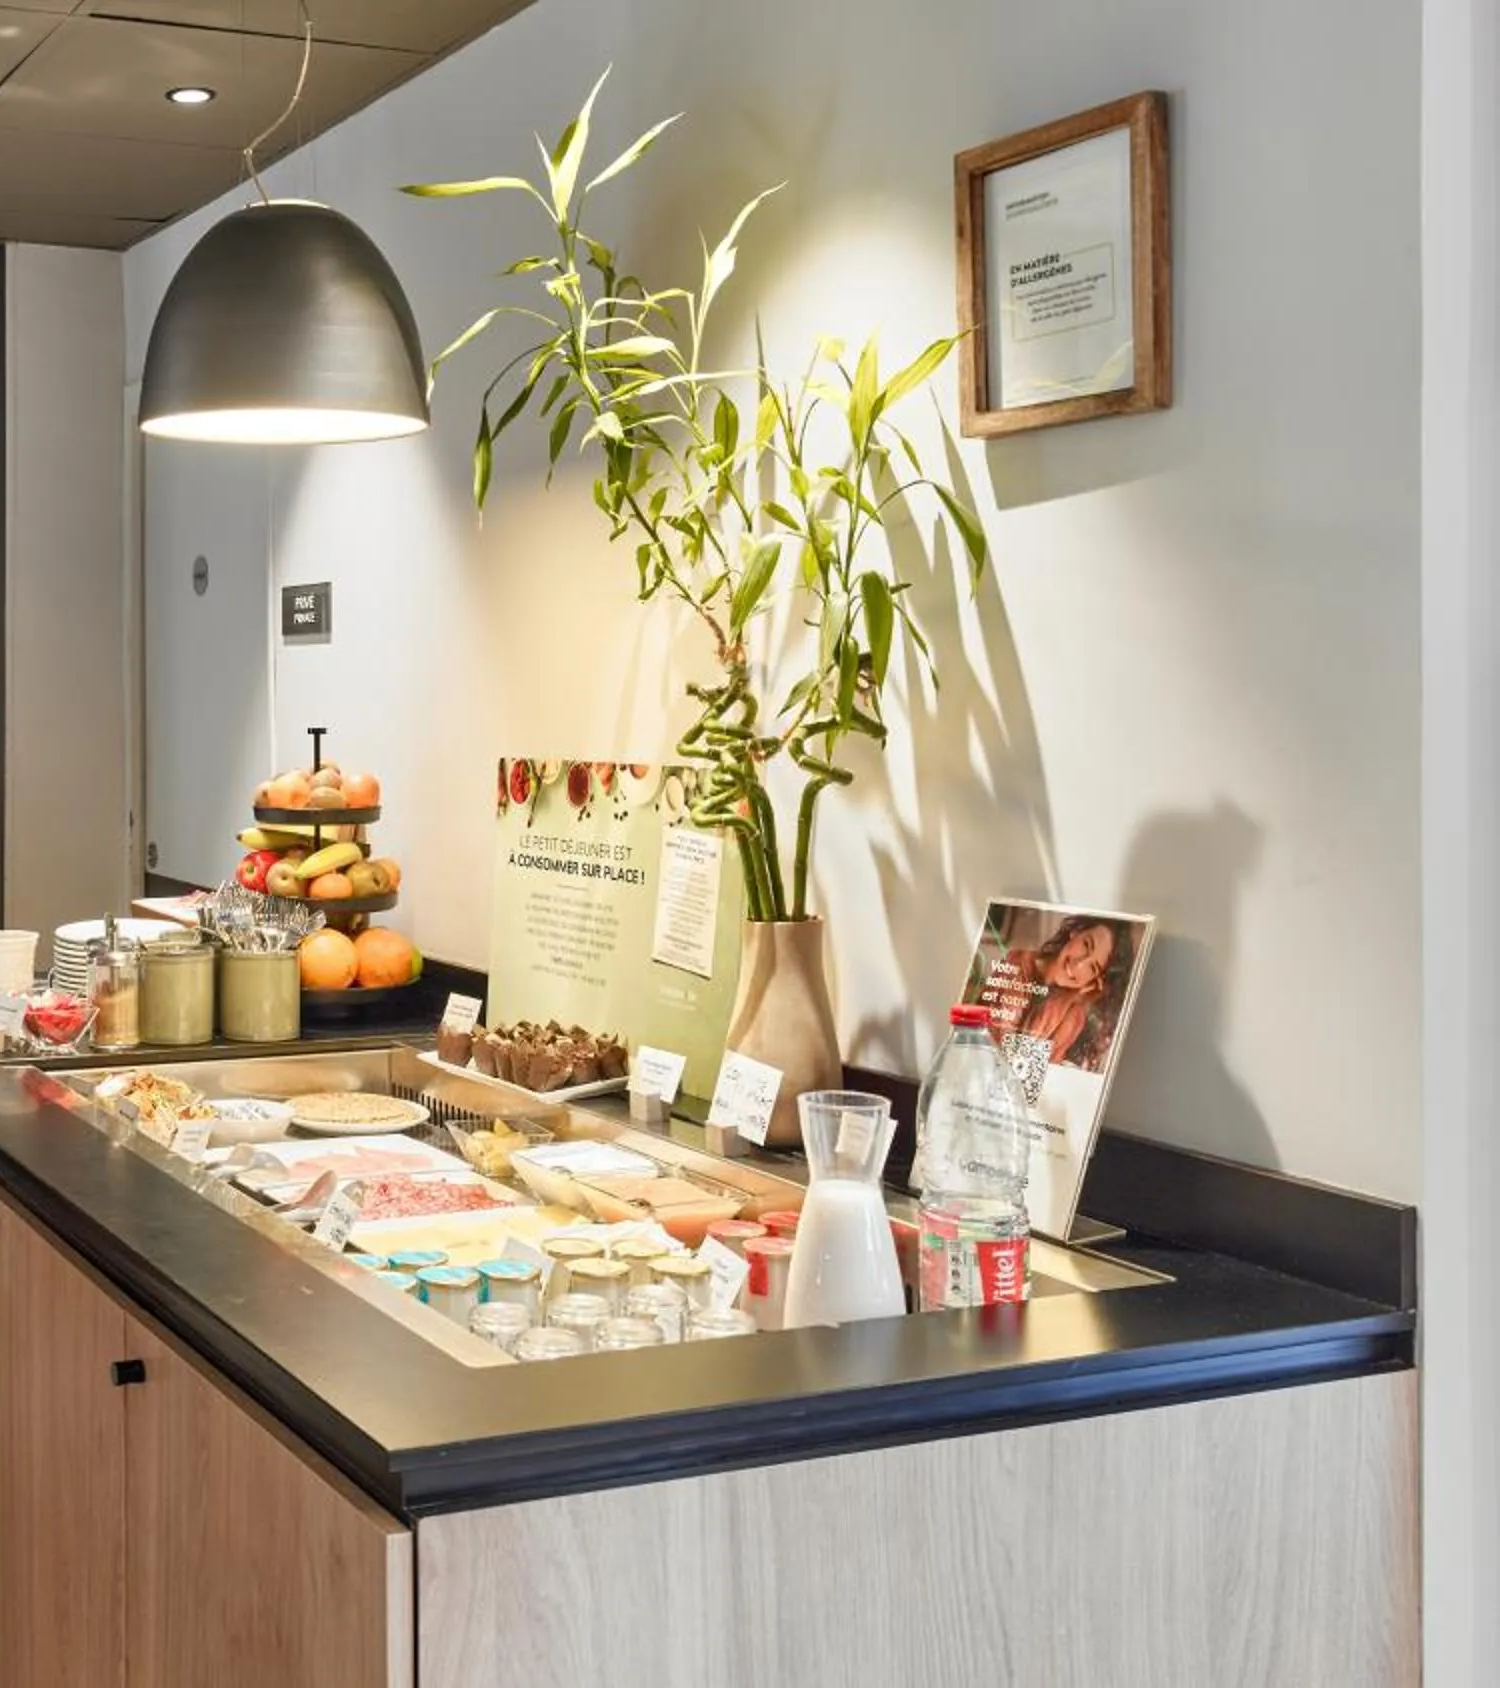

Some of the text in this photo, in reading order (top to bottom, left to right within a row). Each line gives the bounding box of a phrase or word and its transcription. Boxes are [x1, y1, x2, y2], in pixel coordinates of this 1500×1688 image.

[519, 834, 633, 861] LE PETIT DÉJEUNER EST
[517, 853, 579, 875] CONSOMMER
[581, 862, 602, 879] SUR
[604, 866, 639, 885] PLACE
[991, 960, 1020, 975] Votre
[985, 976, 1049, 996] satisfaction
[982, 991, 1029, 1008] est notre
